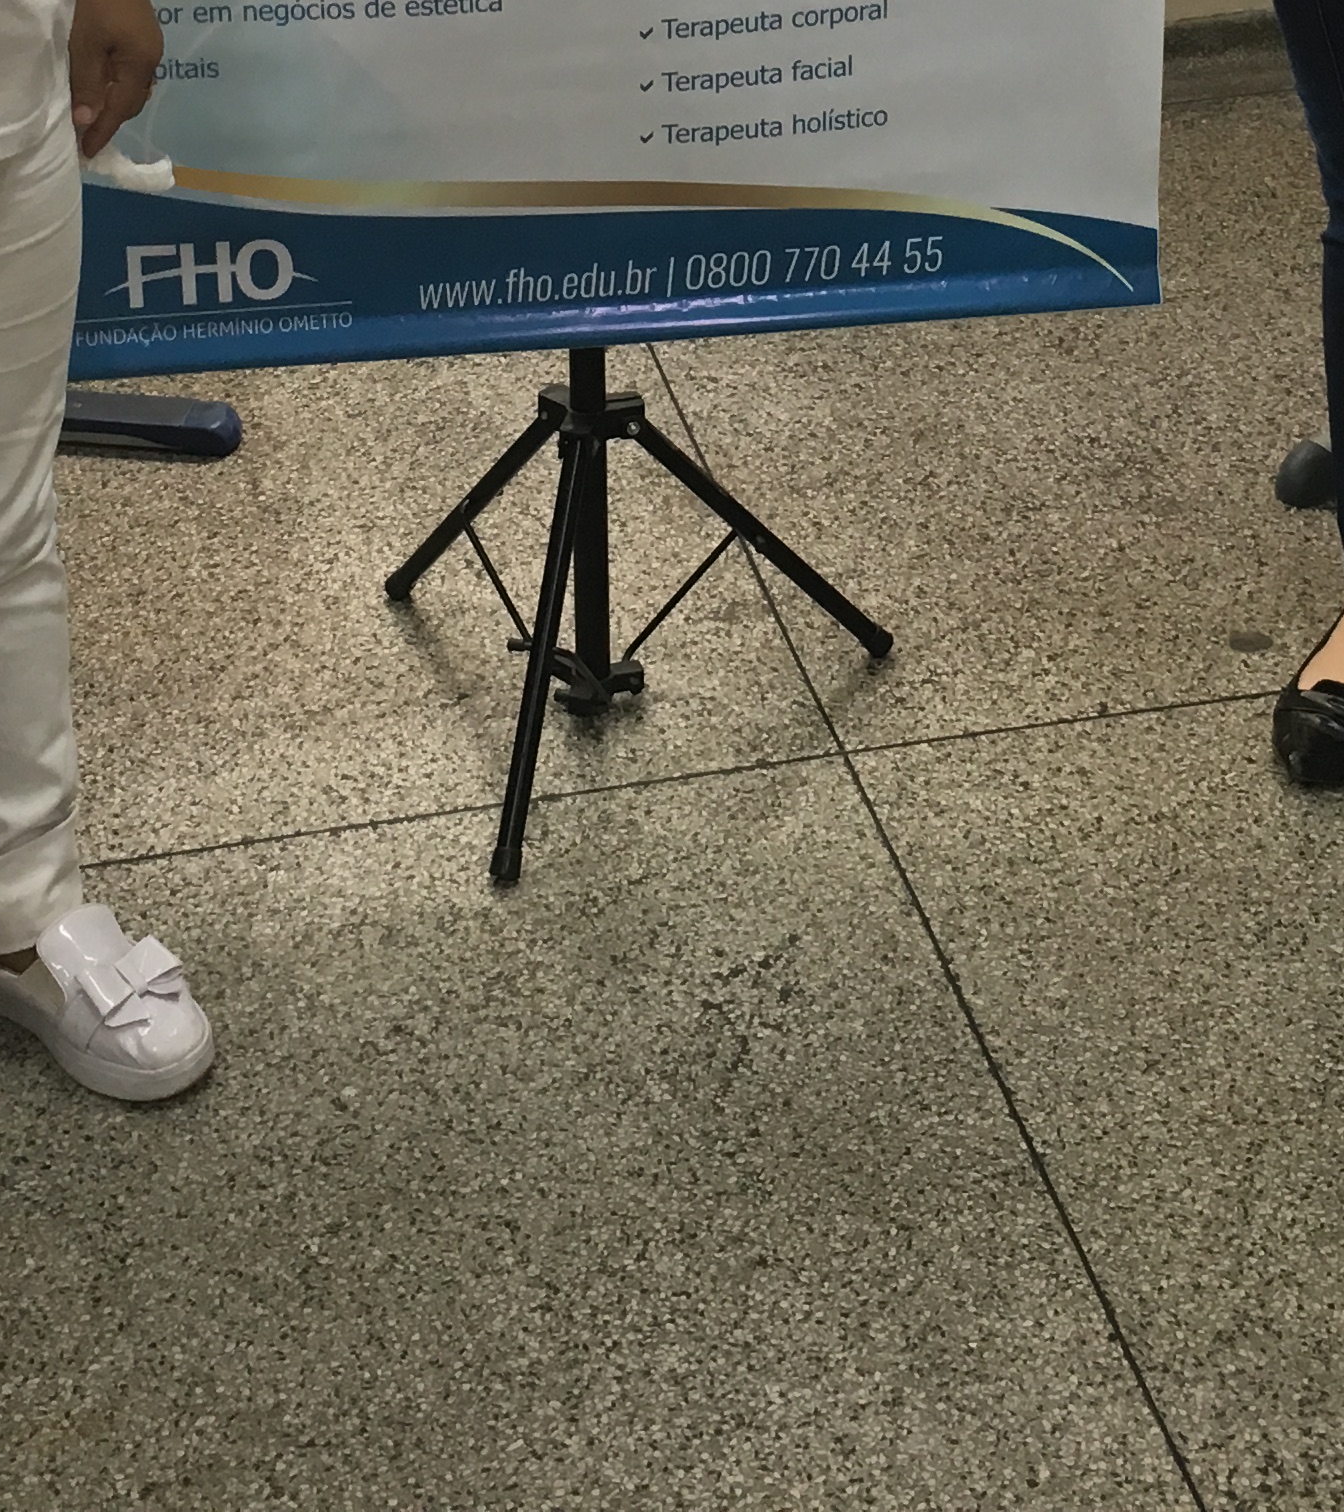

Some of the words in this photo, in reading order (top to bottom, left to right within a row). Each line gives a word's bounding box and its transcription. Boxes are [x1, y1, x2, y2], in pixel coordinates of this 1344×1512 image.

[192, 5, 233, 24] em
[661, 10, 783, 41] Terapeuta
[153, 57, 220, 80] pitais
[661, 64, 783, 95] Terapeuta
[790, 54, 854, 83] facial
[661, 116, 784, 147] Terapeuta
[790, 106, 889, 136] holístico
[125, 237, 296, 310] FHO
[419, 259, 658, 311] www.fho.edu.br
[685, 249, 773, 291] 0800
[783, 245, 842, 284] 770
[850, 240, 893, 278] 44
[903, 235, 945, 274] 55
[75, 321, 178, 348] FUNDAÇÃO
[182, 314, 274, 339] HERMÍNIO
[278, 311, 353, 333] OMETTO
